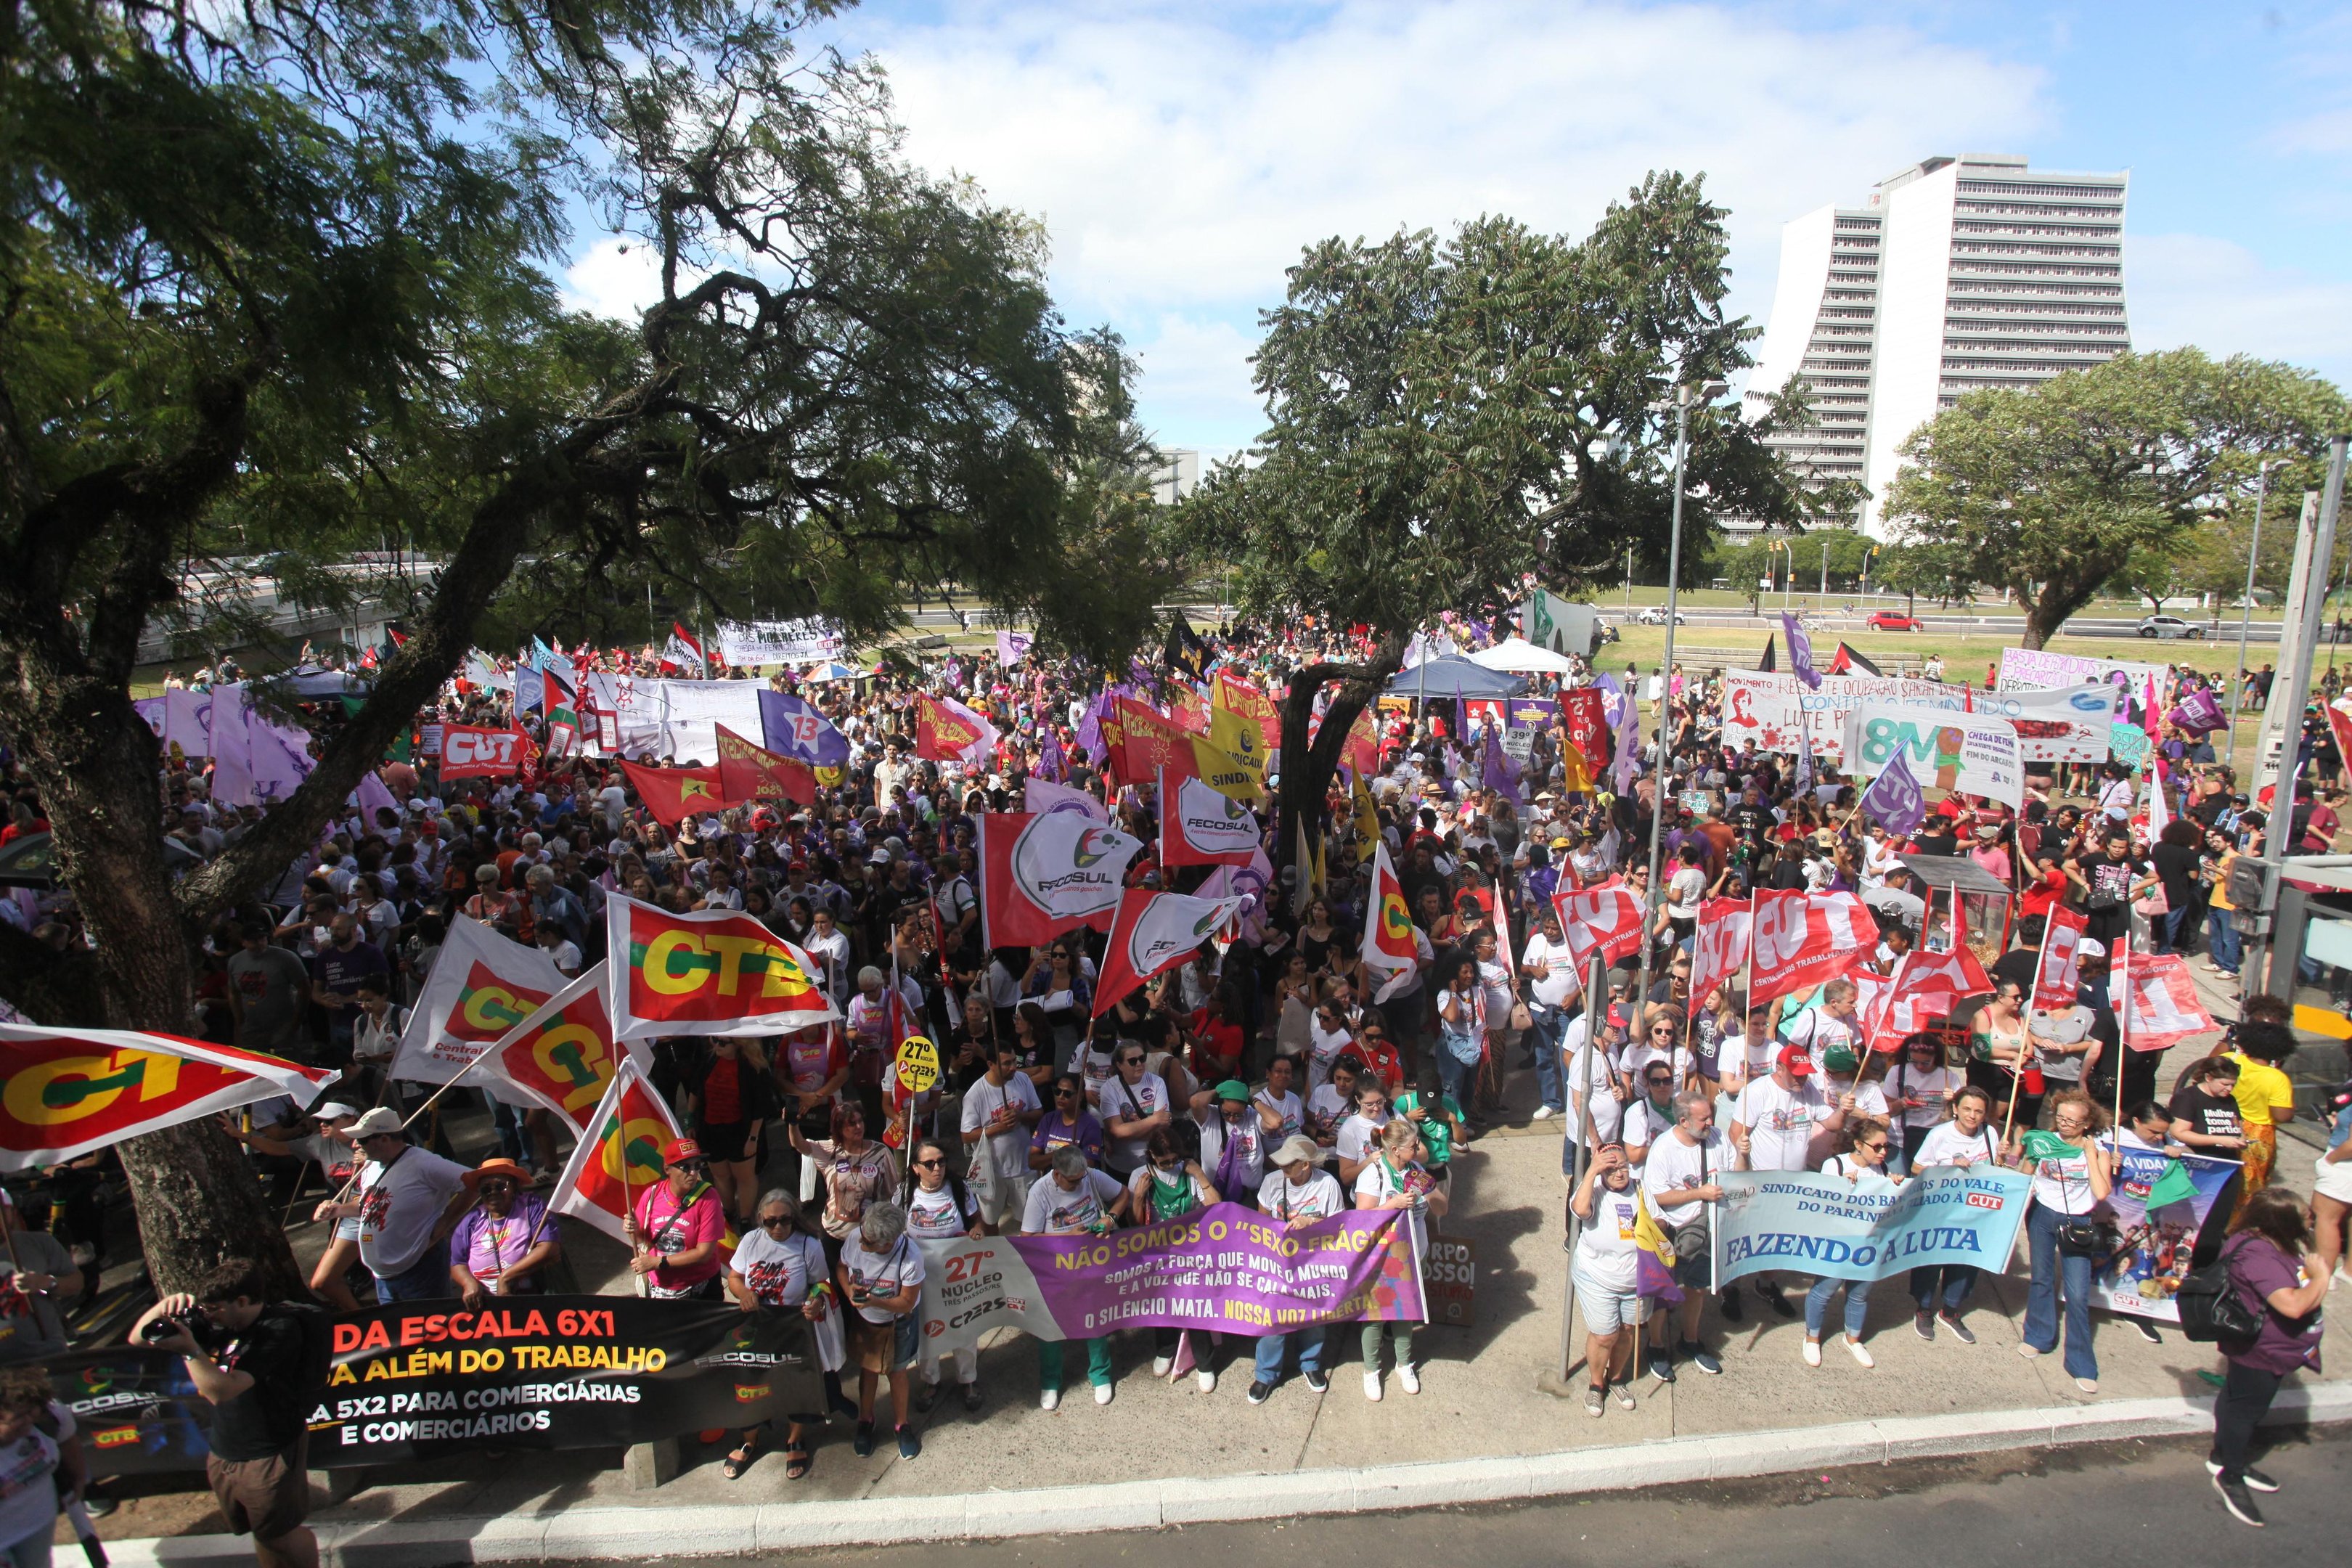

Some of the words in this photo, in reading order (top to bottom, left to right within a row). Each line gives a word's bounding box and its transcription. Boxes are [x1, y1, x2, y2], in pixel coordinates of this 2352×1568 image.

[1728, 678, 1773, 689] MOVIMENTO
[794, 716, 819, 740] 13
[1511, 731, 1530, 740] 39º
[1968, 731, 1993, 743] CHEGA
[446, 732, 519, 764] CUT
[1862, 718, 1943, 769] 8M
[1967, 751, 1979, 759] FIM
[1188, 818, 1253, 833] FECOSUL
[1038, 872, 1113, 891] FECOSUL
[1754, 891, 1858, 970] CUT
[1577, 952, 1592, 969] CENTRA
[1599, 940, 1614, 951] NICA
[435, 1042, 483, 1055] Central
[446, 1053, 473, 1065] Trab
[904, 1041, 930, 1060] 27º
[2123, 1156, 2133, 1167] A
[2134, 1157, 2163, 1169] VIDA
[1760, 1184, 1842, 1203] SINDICATO
[1845, 1192, 1874, 1207] DOS
[1941, 1177, 1960, 1191] DO
[1963, 1177, 2005, 1194] VALE
[1797, 1200, 1819, 1213] DO
[1969, 1196, 2001, 1209] CUT
[1055, 1246, 1110, 1270] NÃO
[1116, 1223, 1201, 1258] SOMOS
[1209, 1221, 1228, 1240] O
[1429, 1242, 1469, 1262] RPO
[1726, 1233, 1877, 1267] FAZENDO
[1882, 1241, 1899, 1265] A
[1903, 1228, 1982, 1255] LUTA
[945, 1250, 995, 1283] 27º
[1105, 1260, 1152, 1284] SOMOS
[1156, 1258, 1164, 1271] A
[1169, 1254, 1213, 1270] FORÇA
[1218, 1252, 1244, 1267] QUE
[1249, 1254, 1283, 1279] MOVE
[1299, 1265, 1349, 1281] MUNDO
[1423, 1262, 1475, 1289] OSSO!
[942, 1272, 1003, 1299] NÚCLEO
[943, 1295, 962, 1307] TRÊS
[963, 1283, 1001, 1303] PASSOS/RS
[1119, 1285, 1127, 1295] E
[1131, 1281, 1140, 1294] A
[1144, 1275, 1169, 1289] VOZ
[1174, 1273, 1199, 1286] QUE
[1205, 1270, 1232, 1286] NÃO
[1237, 1273, 1254, 1288] SE
[1257, 1278, 1290, 1297] CALA
[1293, 1283, 1336, 1300] MAIS.
[950, 1297, 1006, 1329] CPERS
[1085, 1314, 1094, 1329] O
[1099, 1296, 1166, 1326] SILÊNCIO
[1171, 1299, 1219, 1319] MATA.
[1225, 1300, 1273, 1327] NOSSA
[2114, 1293, 2141, 1307] CUT
[333, 1323, 391, 1352] DA
[401, 1310, 550, 1347] ESCALA
[557, 1310, 615, 1336] 6X1
[364, 1347, 452, 1382] ALÉM
[459, 1348, 505, 1373] DO
[511, 1346, 666, 1373] TRABALHO
[693, 1352, 802, 1365] FECOSUL
[337, 1396, 386, 1418] 5X2
[391, 1388, 457, 1413] PARA
[467, 1379, 641, 1408] COMERCIÁRIAS
[97, 1429, 137, 1444] CTB
[341, 1425, 358, 1445] E
[363, 1410, 551, 1442] COMERCIÁRIOS
